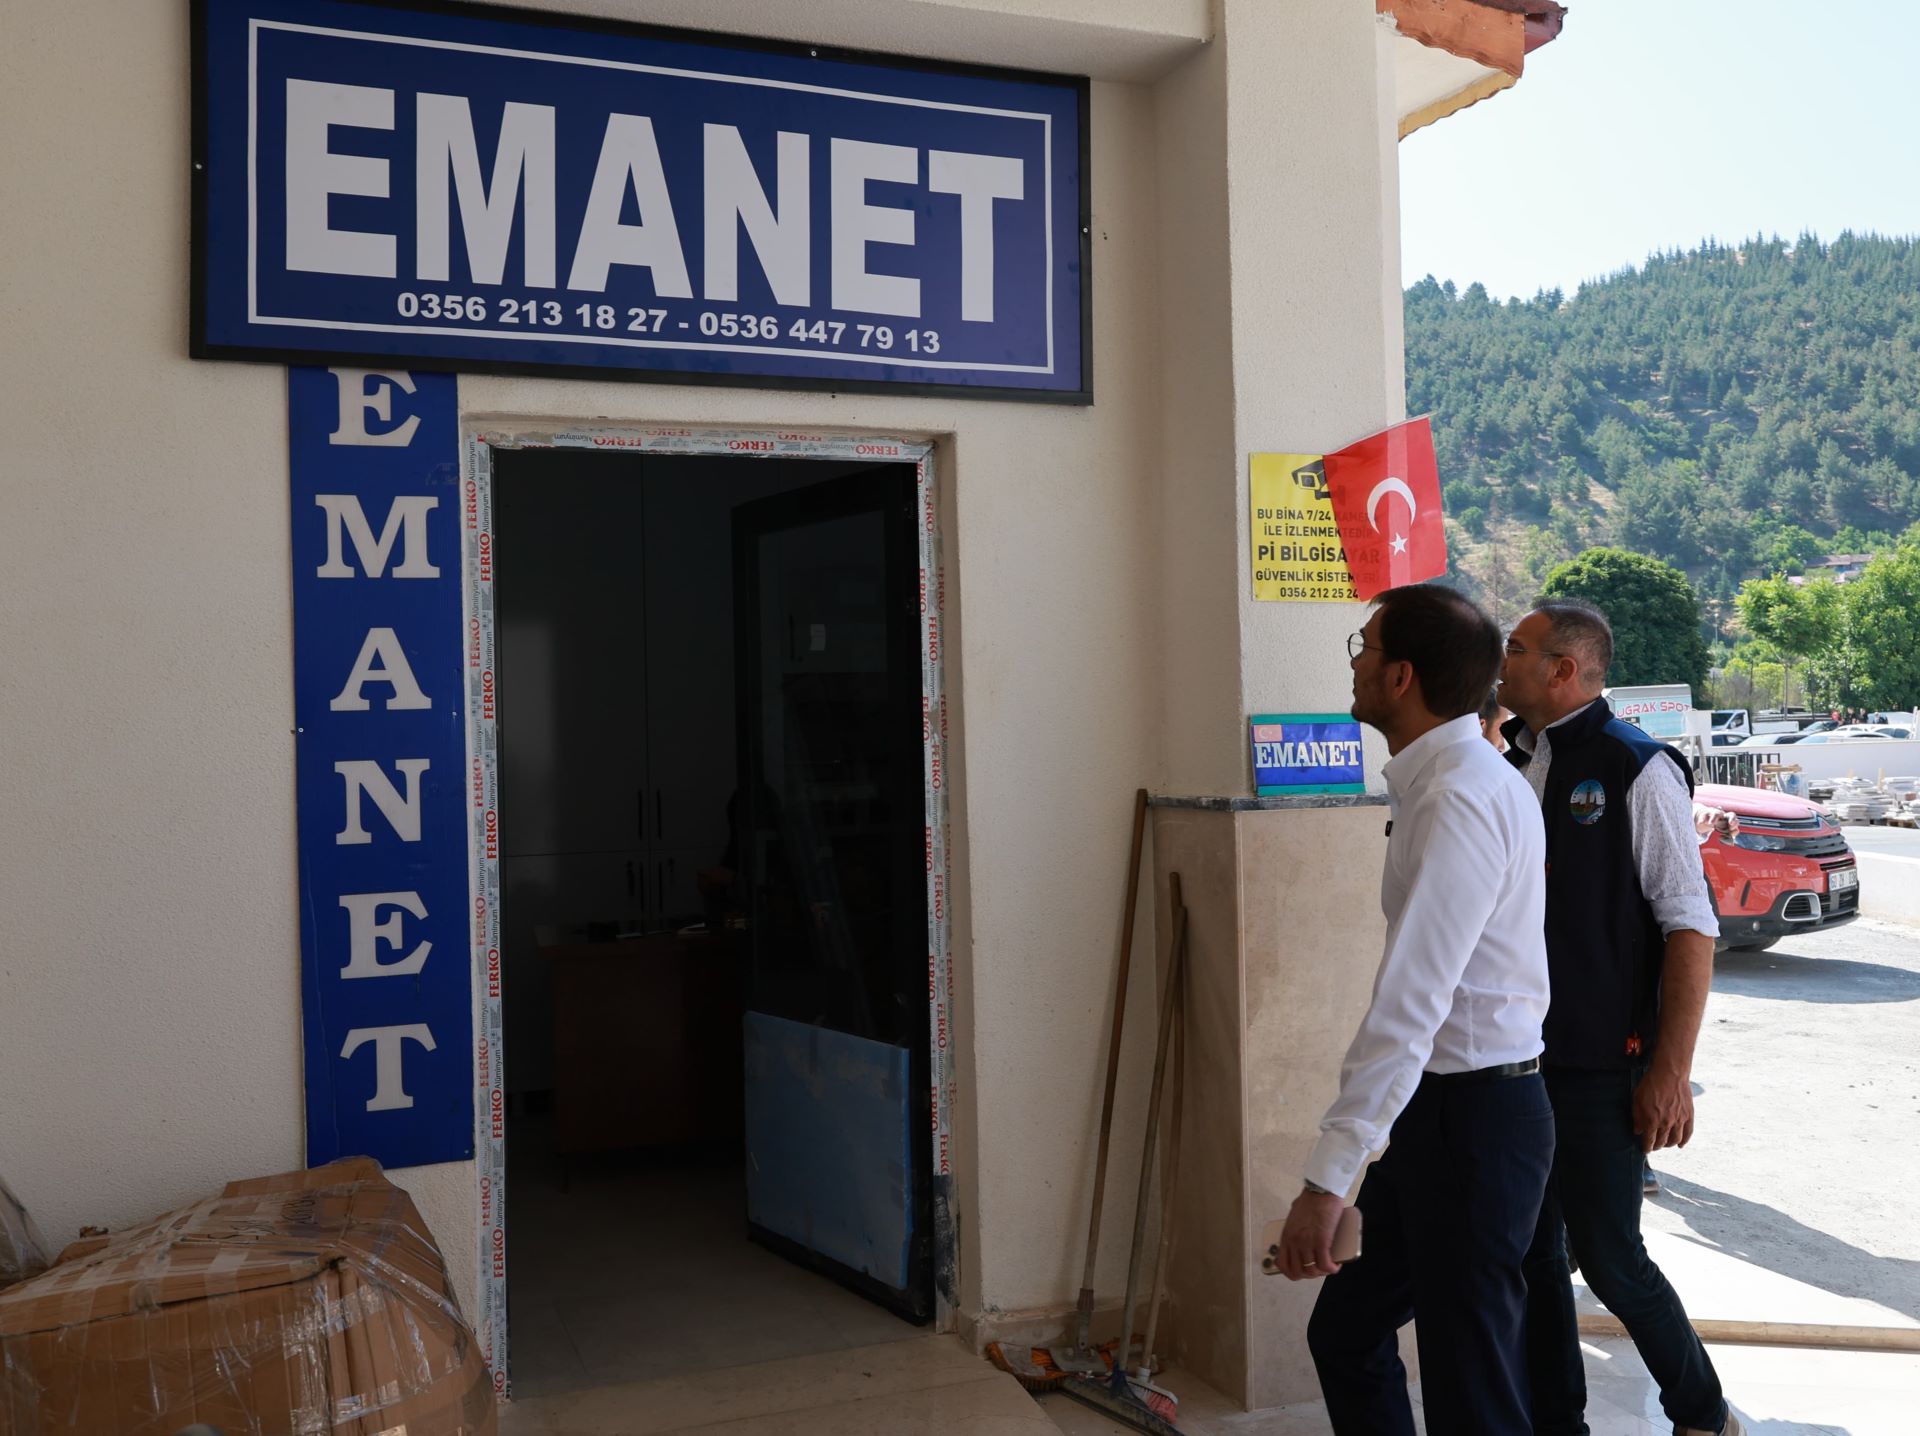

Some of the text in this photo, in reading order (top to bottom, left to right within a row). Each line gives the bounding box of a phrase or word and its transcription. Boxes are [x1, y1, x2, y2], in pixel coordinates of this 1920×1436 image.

[286, 78, 1024, 322] EMANET
[397, 292, 940, 354] 0356 213 18 27 - 0536 447 79 13
[728, 440, 775, 452] FERKO
[856, 444, 899, 456] FERKO
[466, 481, 478, 529] FERKO
[1257, 508, 1273, 520] BU
[1276, 506, 1305, 521] BİNA
[1307, 509, 1332, 522] 7/24
[1258, 541, 1275, 561] Pİ
[1264, 522, 1283, 536] İLE
[480, 533, 491, 581] FERKO
[1255, 568, 1315, 582] GÜVENLİK
[1280, 587, 1359, 599] 0356 212 25 24
[928, 616, 939, 662] FERKO
[483, 671, 494, 719] FERKO
[1660, 701, 1691, 713] SPOT
[315, 367, 440, 1112] EMANET
[1254, 741, 1361, 768] EMANET
[931, 744, 942, 790] FERKO
[486, 810, 497, 858] FERKO
[934, 874, 944, 920] FERKO
[489, 949, 500, 998] FERKO
[937, 1003, 947, 1049] FERKO
[491, 1090, 502, 1139] FERKO
[493, 1229, 504, 1278] FERKO
